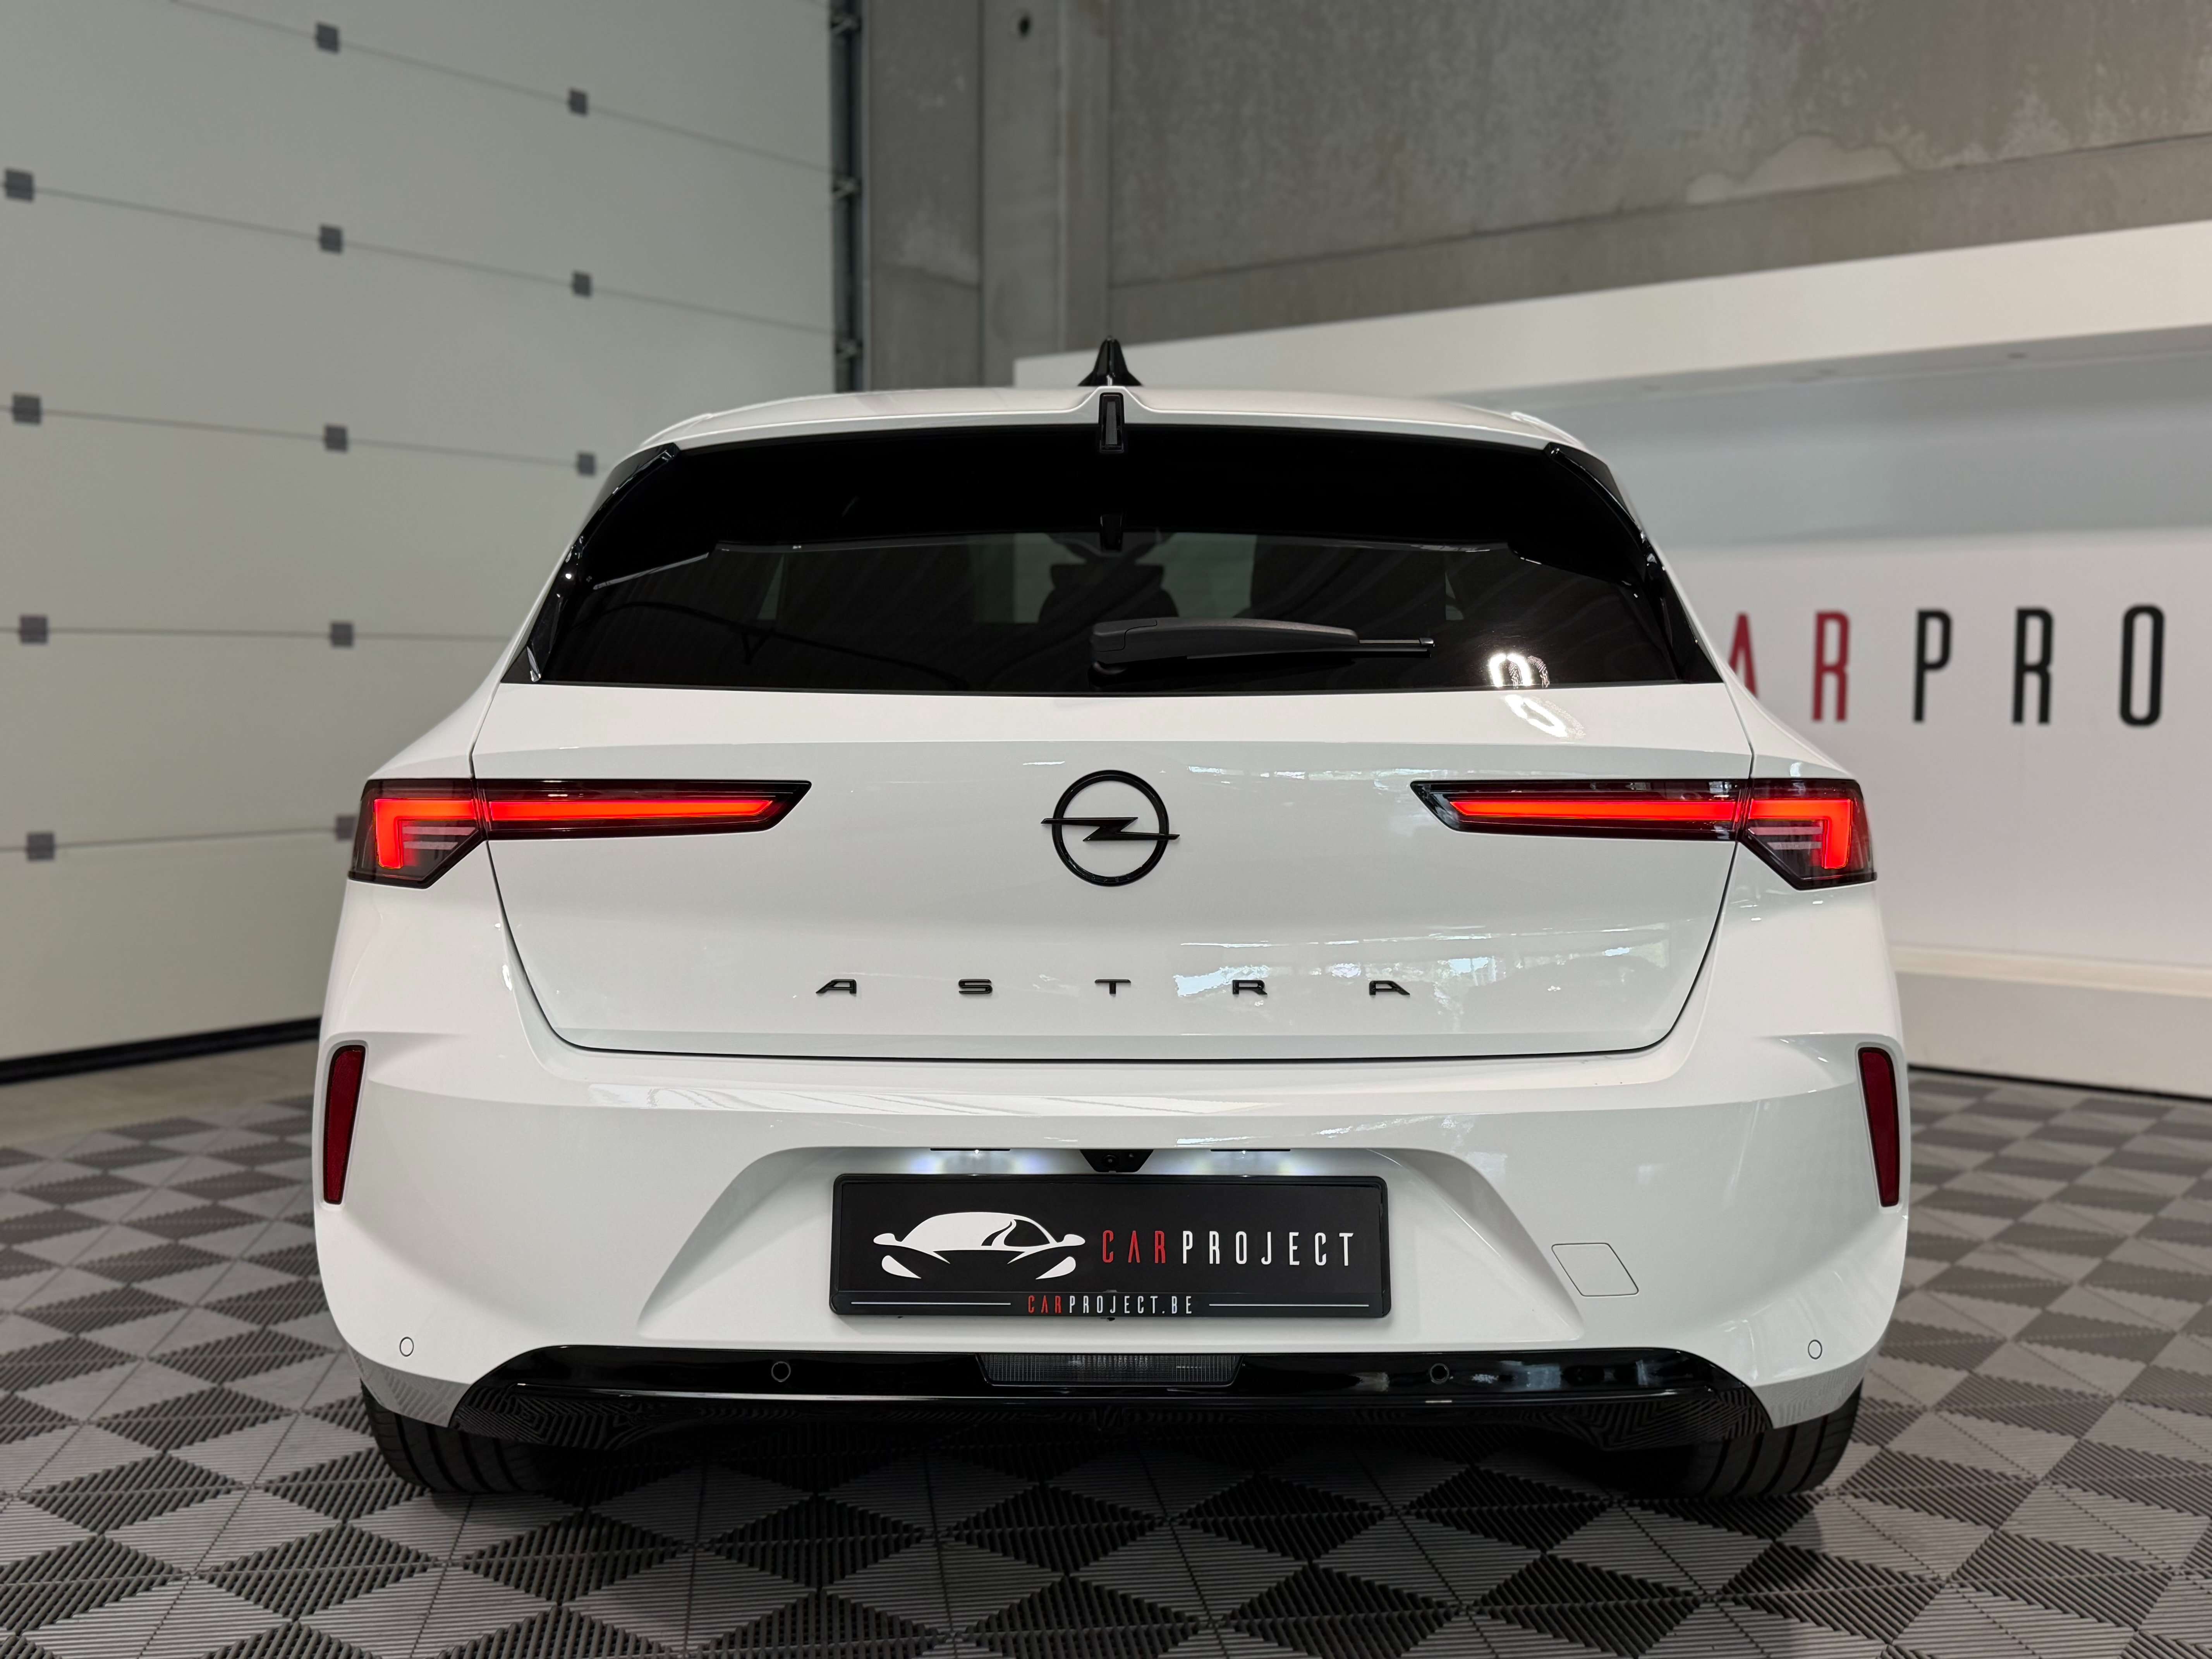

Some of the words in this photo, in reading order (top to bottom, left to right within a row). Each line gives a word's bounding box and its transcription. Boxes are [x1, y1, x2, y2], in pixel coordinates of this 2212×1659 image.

[815, 979, 1411, 996] ASTRA
[1102, 1230, 1354, 1267] CARPROJECT
[1028, 1295, 1193, 1314] CARPROJECT.BE
